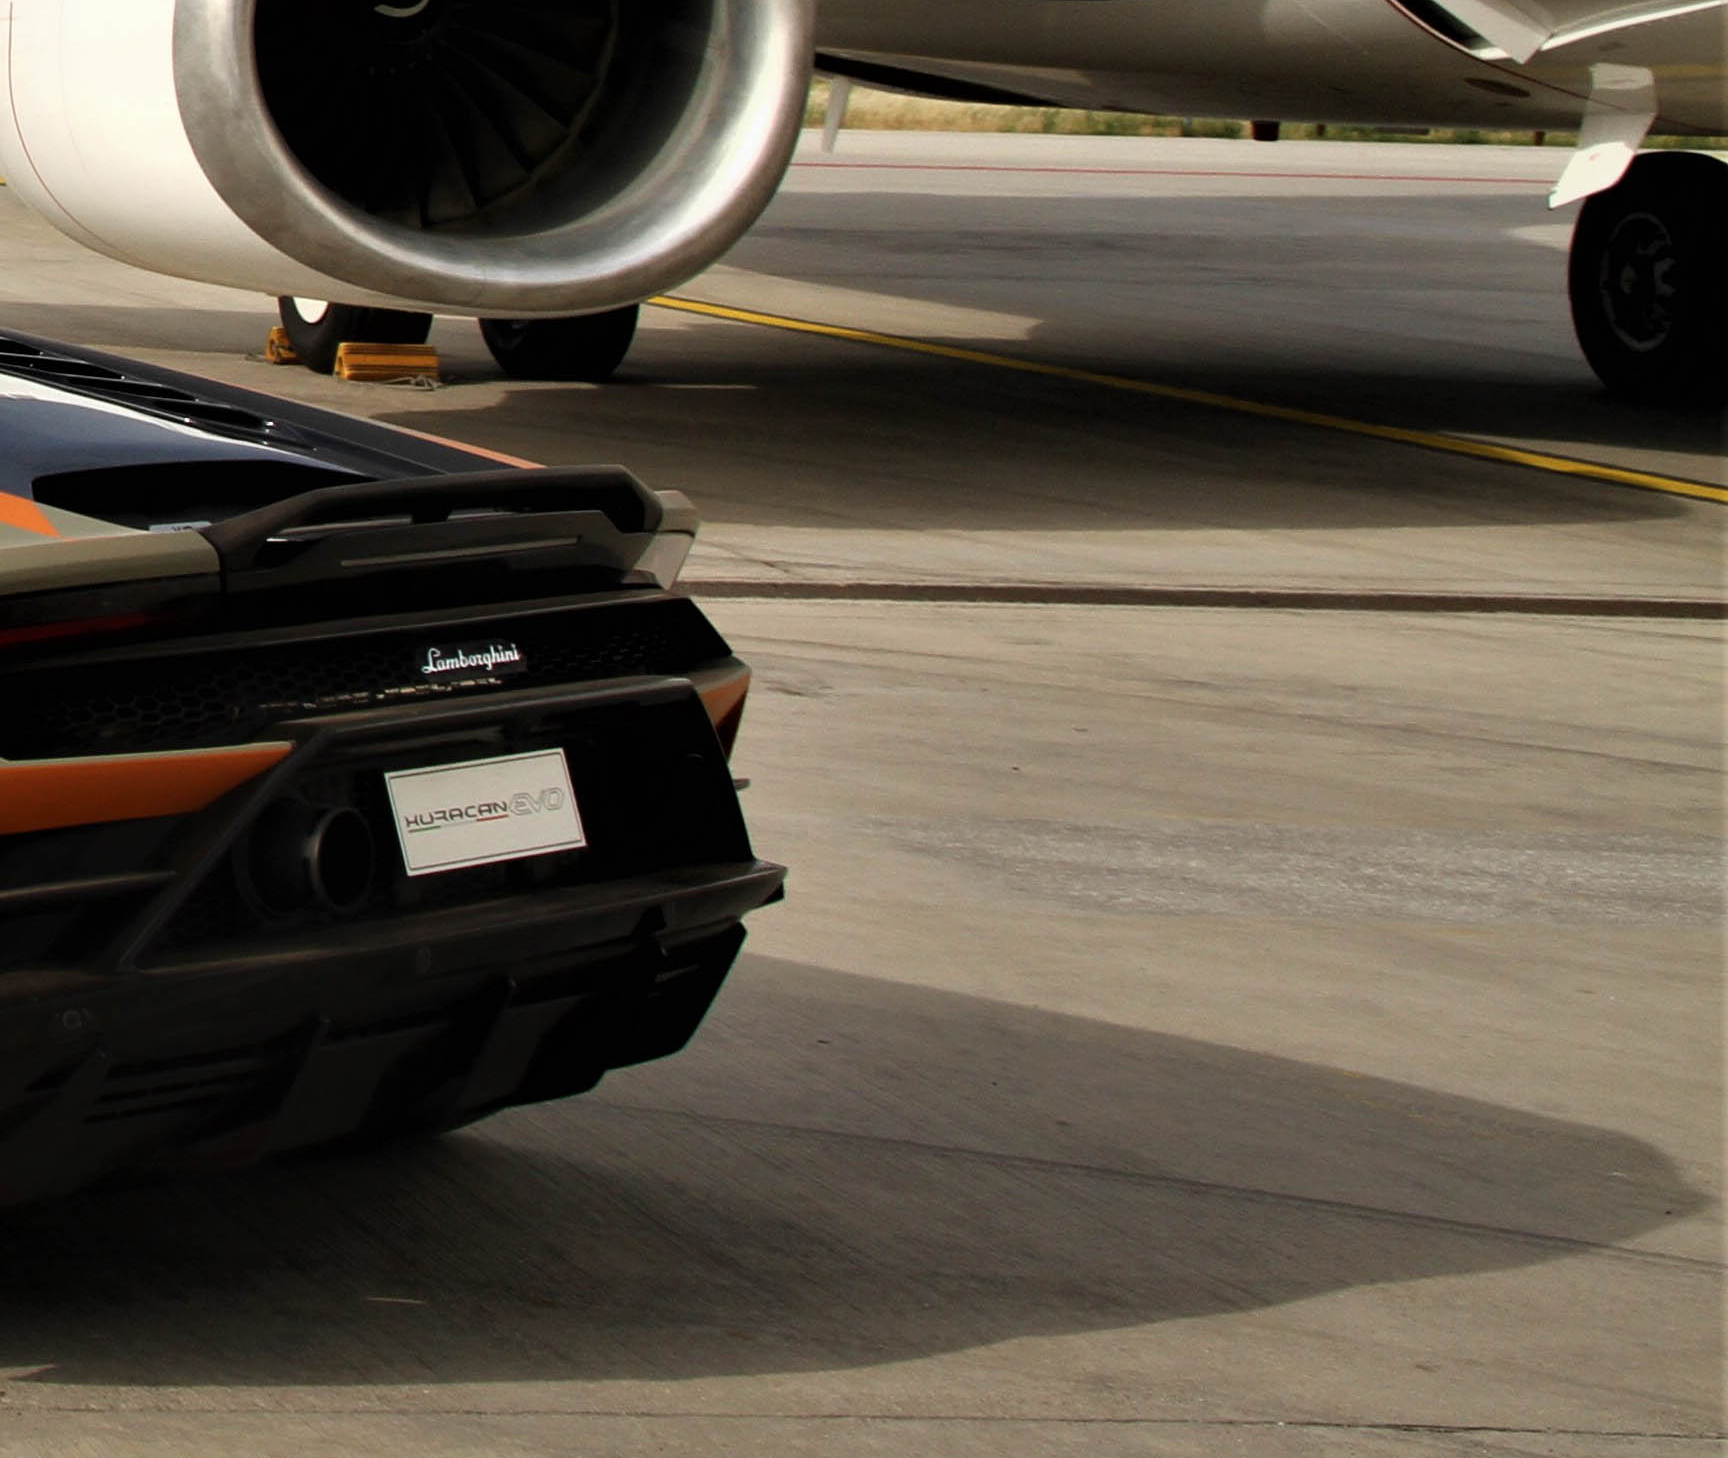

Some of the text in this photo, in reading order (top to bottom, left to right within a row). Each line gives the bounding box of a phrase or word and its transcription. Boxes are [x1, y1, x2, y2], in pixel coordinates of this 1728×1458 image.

[421, 643, 520, 674] Lamborghini
[405, 786, 566, 828] HURACAN EVO
